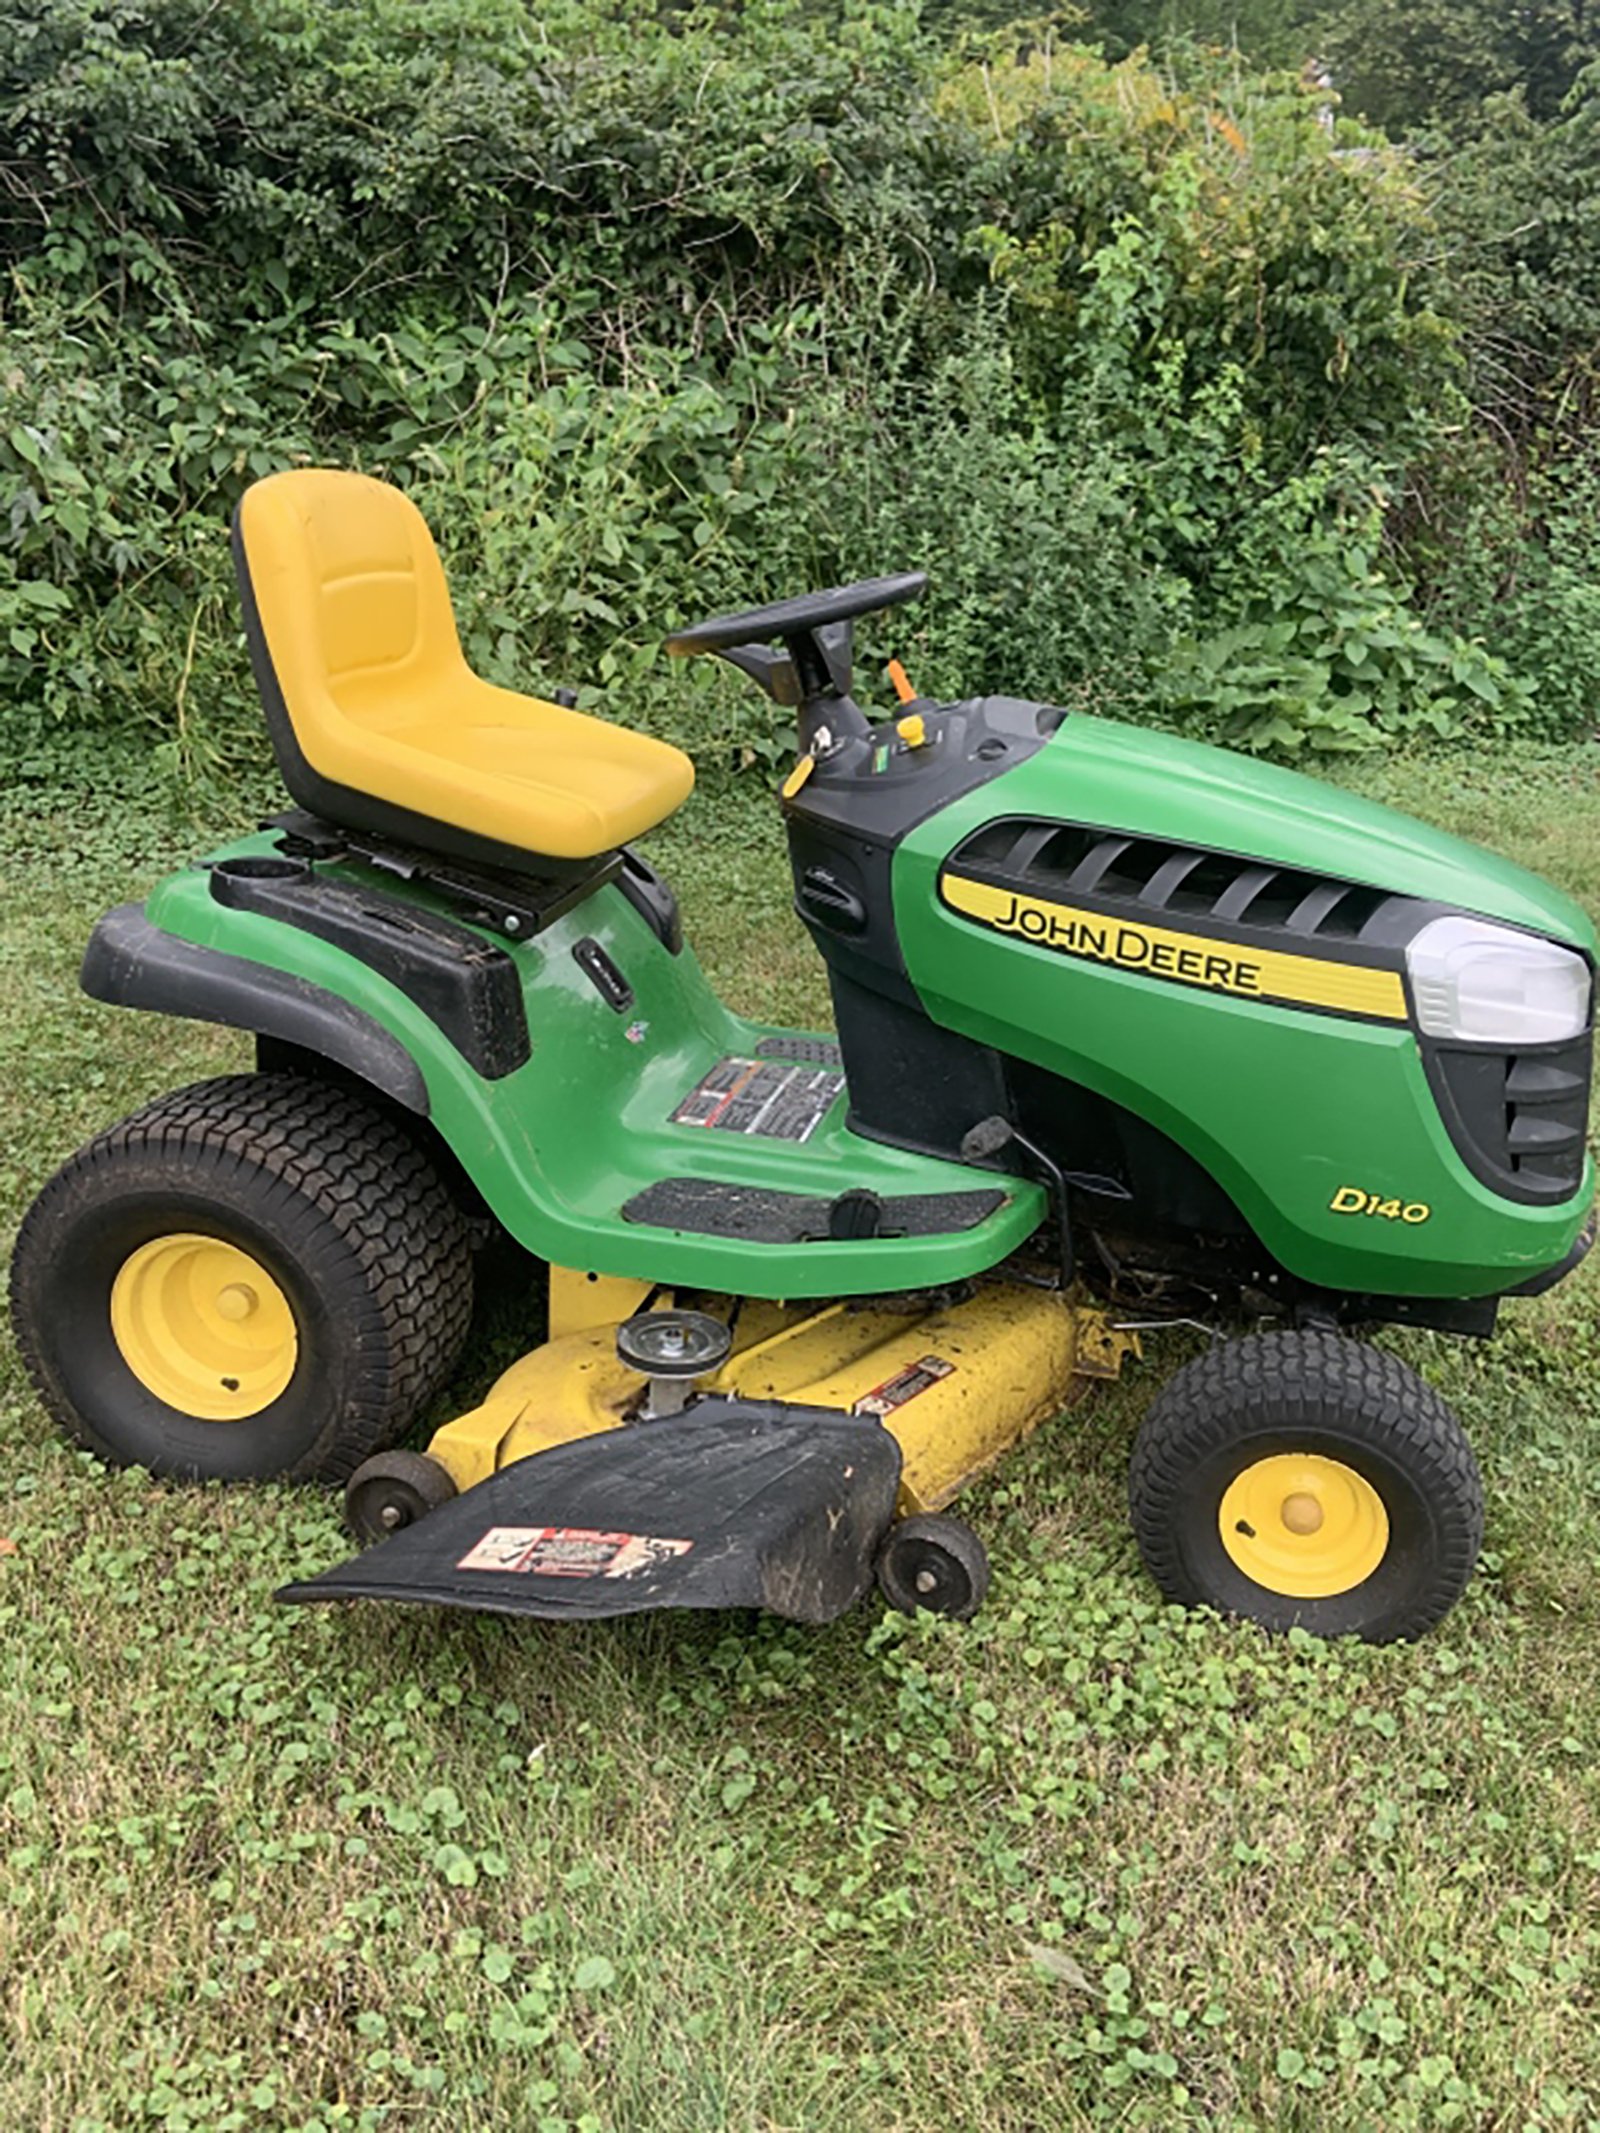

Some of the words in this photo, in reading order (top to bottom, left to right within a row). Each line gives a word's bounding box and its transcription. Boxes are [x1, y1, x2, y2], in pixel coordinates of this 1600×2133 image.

[994, 898, 1106, 956] JOHN
[1116, 930, 1261, 991] DEERE
[1329, 1186, 1431, 1224] D140
